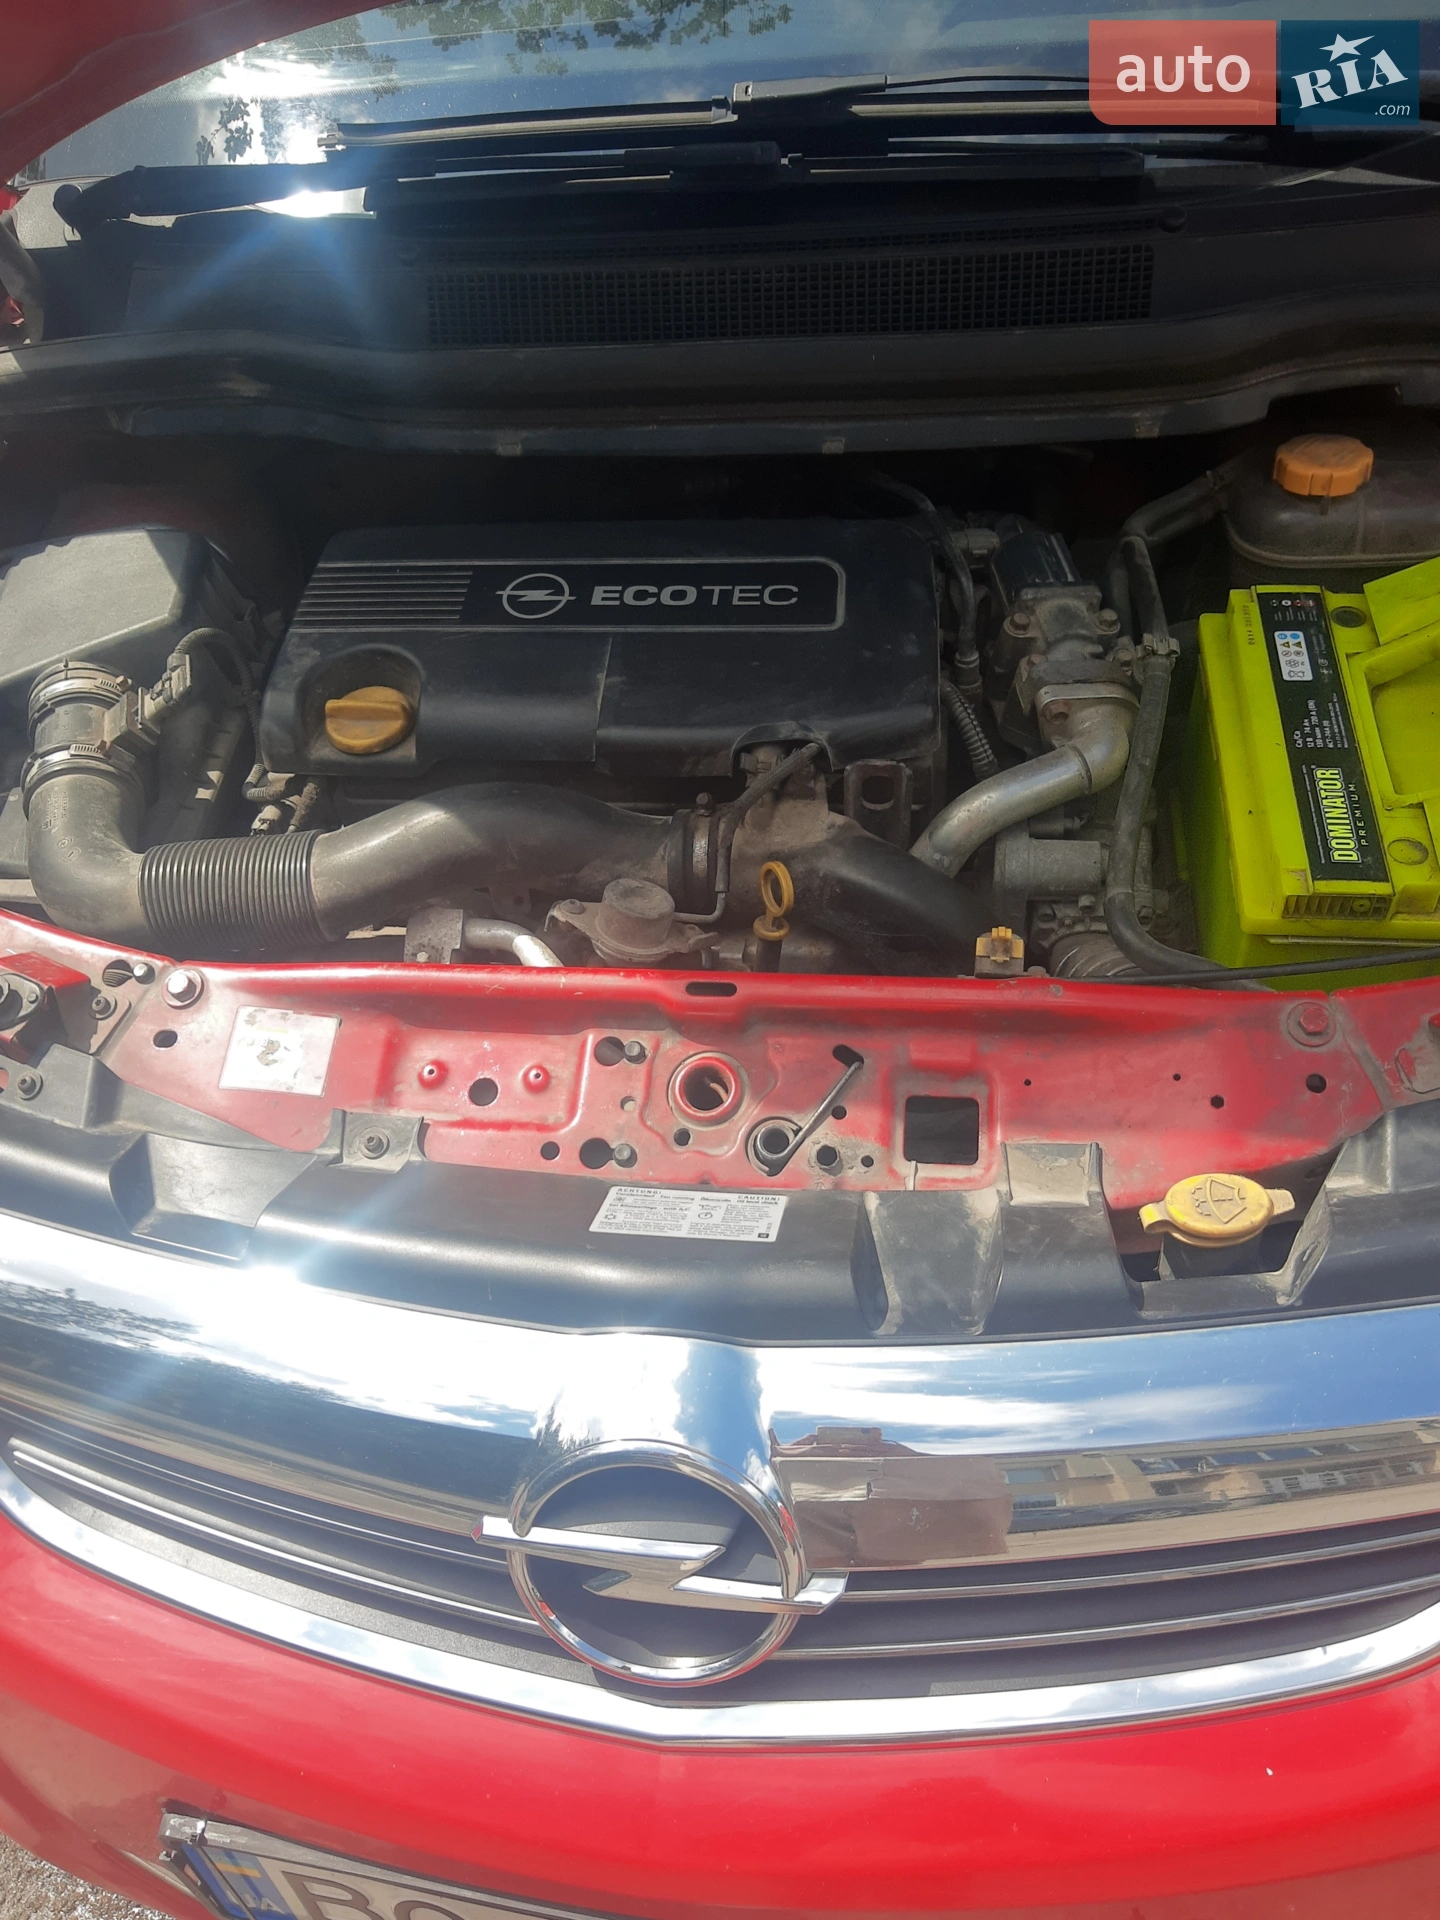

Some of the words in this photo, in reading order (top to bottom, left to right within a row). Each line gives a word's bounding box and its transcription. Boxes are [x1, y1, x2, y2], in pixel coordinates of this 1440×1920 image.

[590, 584, 799, 606] ECOTEC
[1293, 730, 1303, 748] Ca/Ca
[1315, 768, 1361, 862] DOMINATOR
[1348, 783, 1369, 846] PREMIUM
